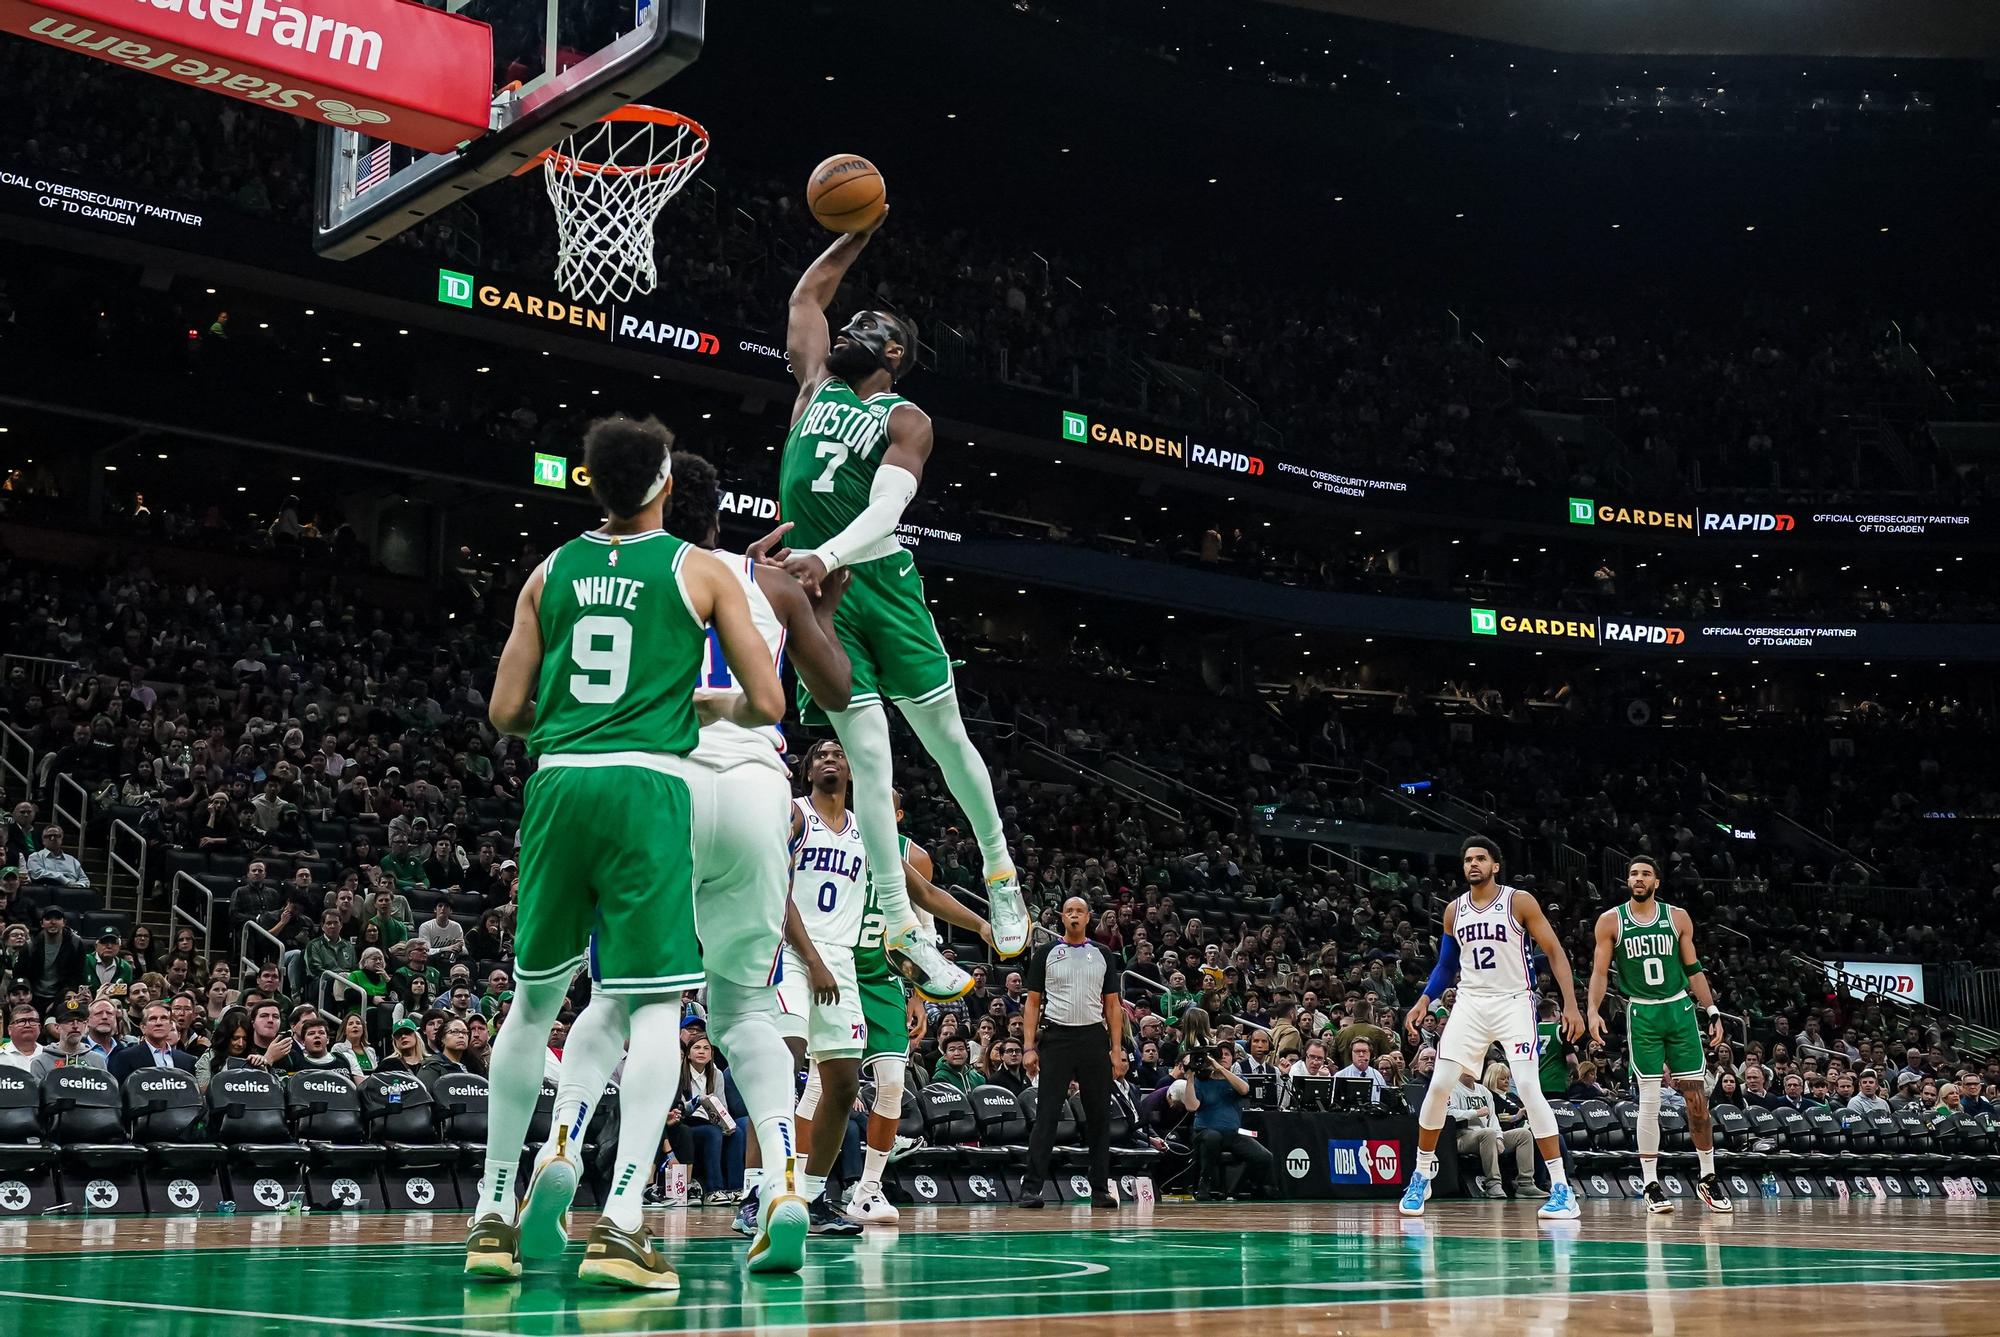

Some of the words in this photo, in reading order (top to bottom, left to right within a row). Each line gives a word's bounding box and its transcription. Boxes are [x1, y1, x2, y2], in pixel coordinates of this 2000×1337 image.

[28, 17, 184, 70] Farm
[246, 0, 383, 72] Farm
[0, 172, 32, 189] CIAL
[35, 180, 144, 213] CYBERSECURITY
[144, 205, 202, 226] PARTNER
[39, 196, 59, 207] OF
[61, 200, 79, 213] TD
[81, 205, 136, 226] GARDEN
[442, 275, 470, 301] TD
[479, 285, 606, 331] GARDEN
[620, 314, 720, 355] RAPID7
[739, 341, 782, 359] OFFICIAL
[800, 401, 884, 460] BOSTON
[1066, 416, 1085, 438] TD
[1091, 423, 1182, 459] GARDEN
[1191, 444, 1264, 476] RAPID7
[538, 458, 562, 481] TD
[811, 441, 849, 492] 7
[1278, 462, 1309, 477] OFFICIAL
[1309, 470, 1369, 488] CYBERSECURITY
[1369, 478, 1407, 492] PARTNER
[1312, 481, 1323, 490] OF
[1323, 483, 1333, 493] TD
[1333, 484, 1365, 497] GARDEN
[718, 492, 780, 521] APID
[1571, 502, 1592, 519] TD
[1598, 506, 1692, 529] GARDEN
[1704, 513, 1795, 531] RAPID7
[1812, 514, 1854, 524] OFFICIAL
[1855, 514, 1929, 524] CYBERSECURITY
[1929, 515, 1970, 525] PARTNER
[1859, 524, 1872, 533] OF
[1873, 525, 1886, 533] TD
[1887, 524, 1924, 533] GARDEN
[896, 523, 923, 535] CURITY
[924, 528, 961, 542] PARTNER
[896, 534, 919, 546] RDEN
[572, 576, 644, 611] WHITE
[1475, 613, 1495, 631] TD
[1500, 615, 1595, 638] GARDEN
[1605, 622, 1685, 645] RAPID7
[1702, 626, 1743, 636] OFFICIAL
[1744, 627, 1816, 638] CYBERSECURITY
[1816, 628, 1857, 638] PARTNER
[1762, 637, 1774, 646] TD
[1775, 638, 1812, 646] GARDEN
[569, 615, 633, 704] 9
[695, 626, 732, 689] 1
[1735, 829, 1756, 839] Bank
[817, 881, 837, 912] 0
[1457, 922, 1507, 946] PHILA
[1472, 946, 1496, 970] 12
[1624, 934, 1674, 959] BOSTON
[1643, 958, 1665, 985] 0
[1515, 1042, 1530, 1054] 76
[60, 1077, 108, 1091] @celtics
[141, 1077, 187, 1091] @celtics
[224, 1081, 269, 1093] @celtics
[303, 1080, 347, 1094] @celtics
[931, 1093, 962, 1105] @celtics
[984, 1096, 1014, 1106] @celtics
[1286, 1158, 1310, 1170] TNT
[1334, 1148, 1357, 1175] NBA
[1375, 1157, 1397, 1170] TNT
